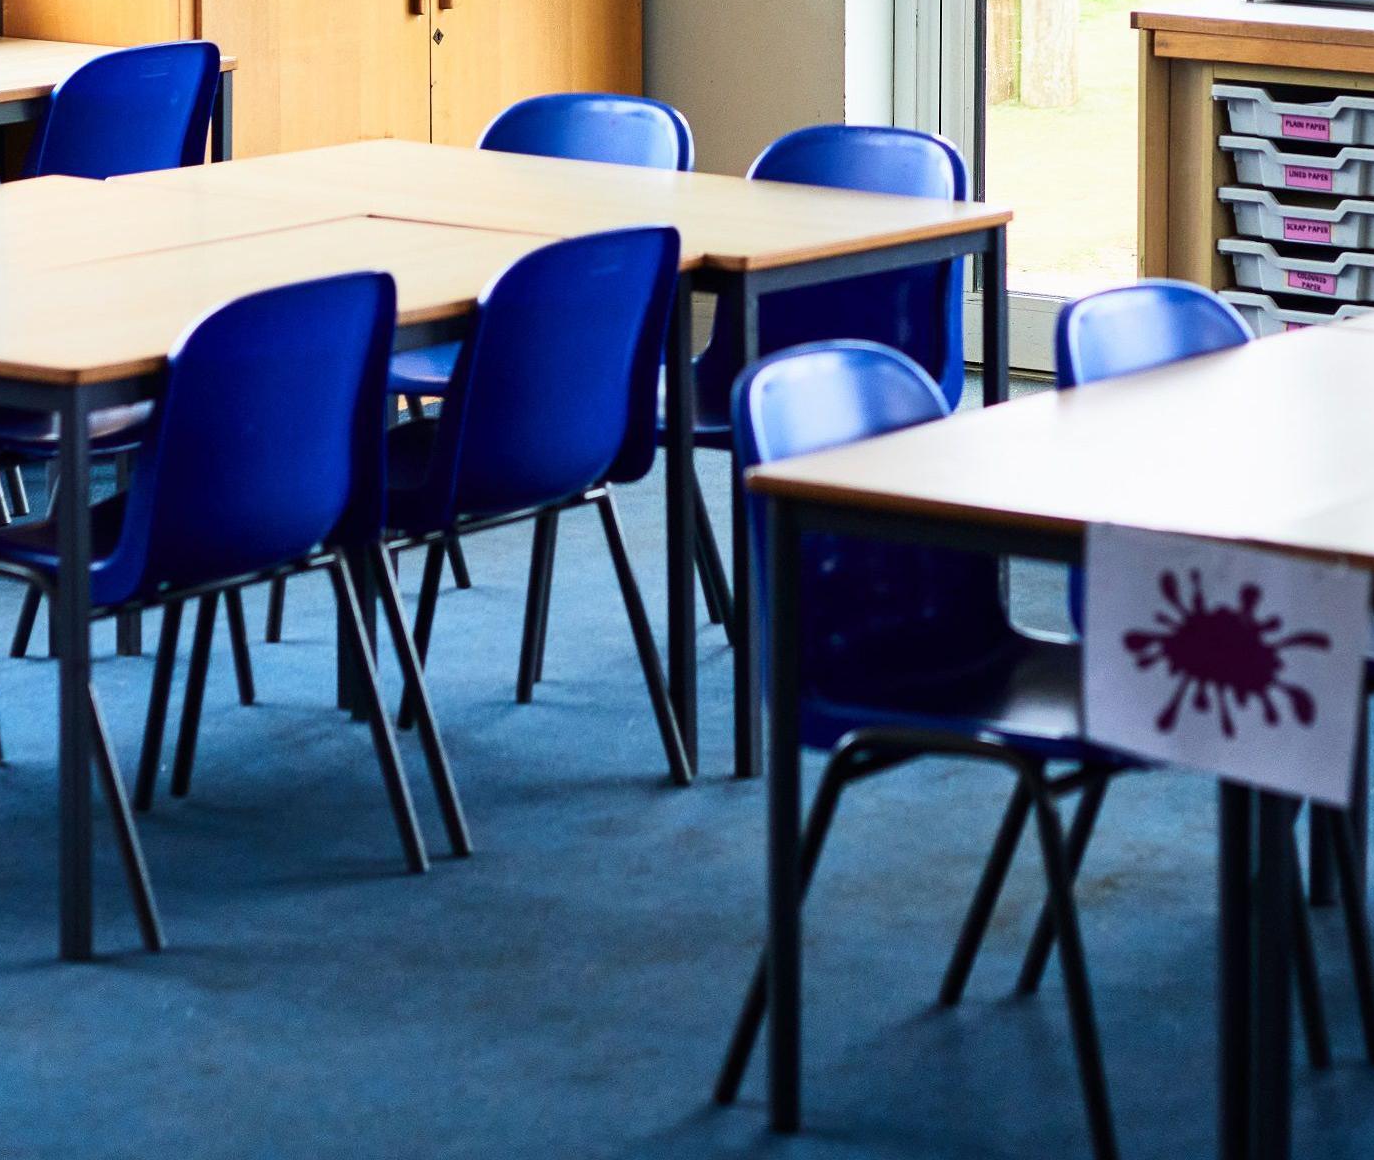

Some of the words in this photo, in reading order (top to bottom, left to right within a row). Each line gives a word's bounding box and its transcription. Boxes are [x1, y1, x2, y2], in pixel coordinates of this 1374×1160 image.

[1286, 120, 1304, 129] PLAIN
[1305, 122, 1326, 131] PAPER
[1288, 170, 1307, 179] LINED
[1308, 172, 1329, 181] PAPER
[1286, 223, 1307, 232] SCRAP
[1308, 225, 1329, 234] PAPER
[1301, 281, 1322, 291] PAPER
